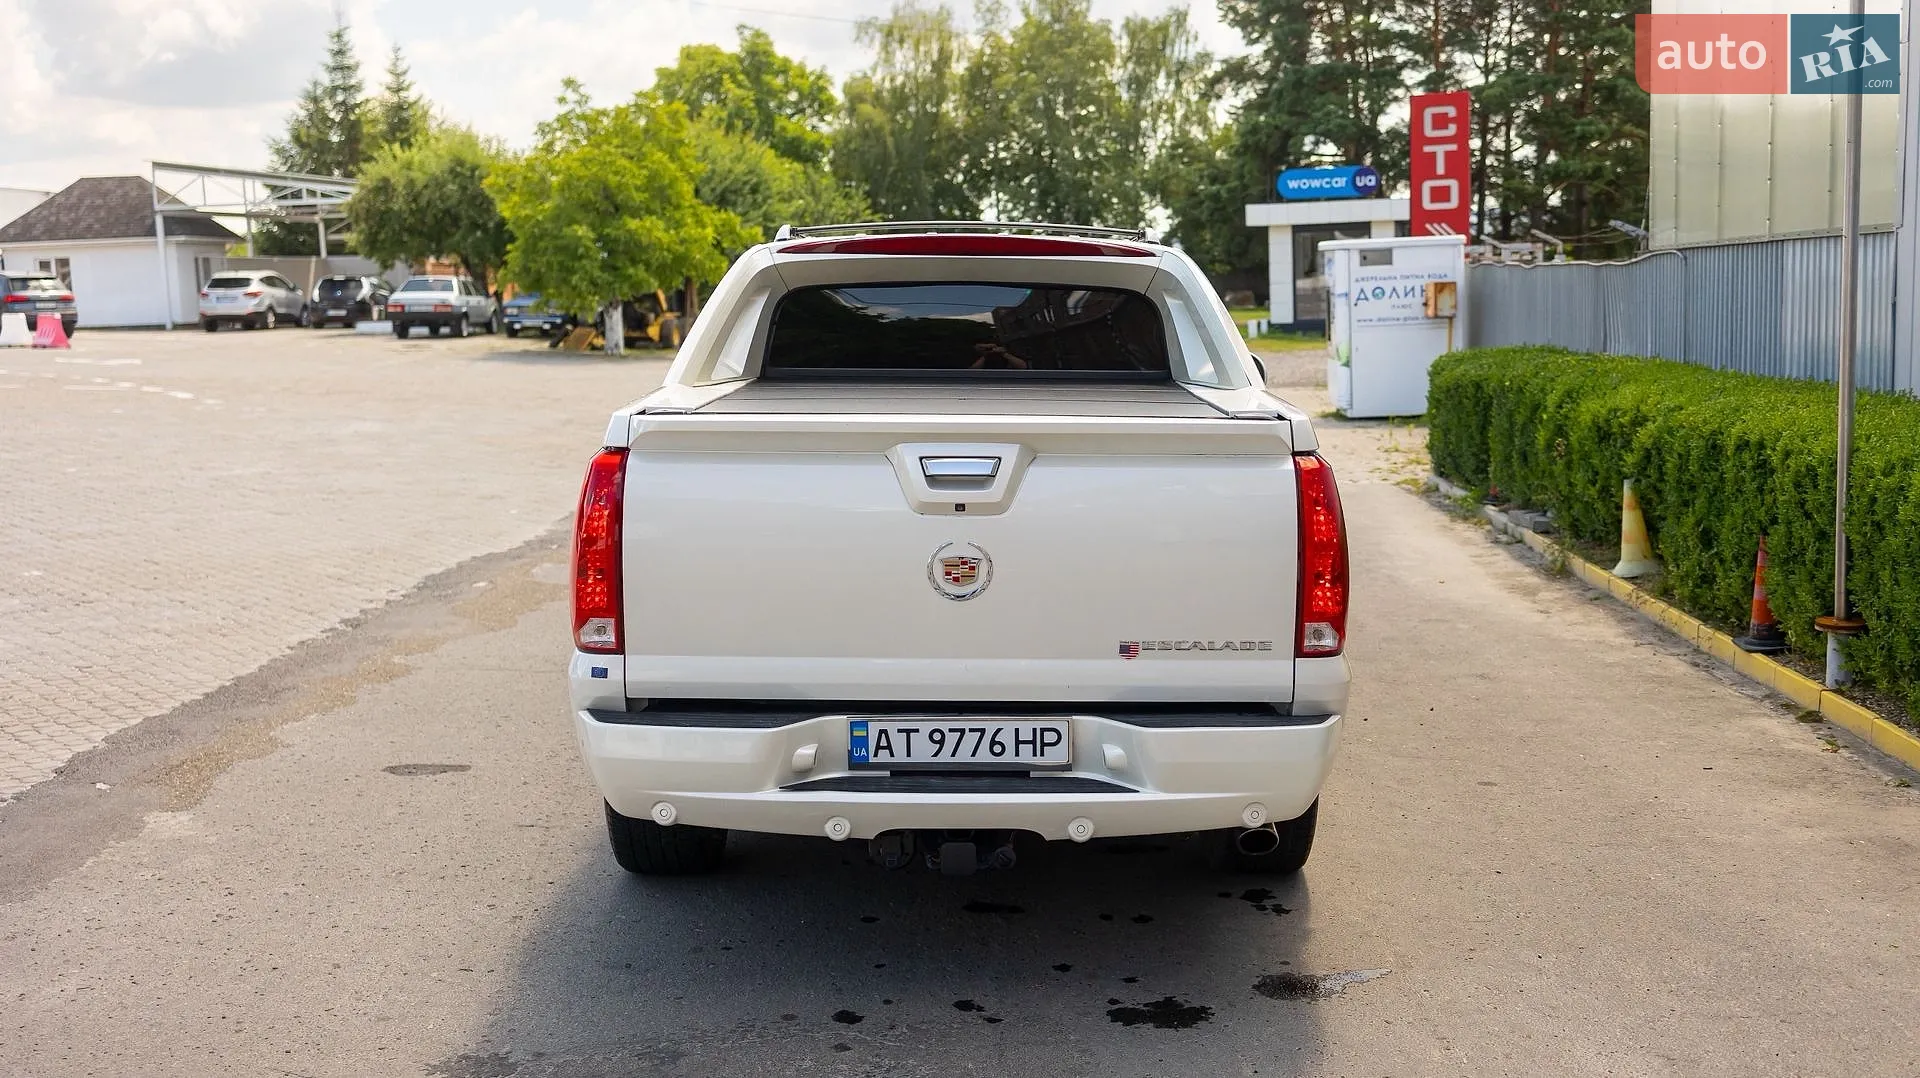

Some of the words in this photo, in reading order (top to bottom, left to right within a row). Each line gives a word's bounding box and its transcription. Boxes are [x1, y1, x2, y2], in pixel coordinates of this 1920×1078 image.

[1421, 105, 1460, 211] СТО
[1287, 176, 1347, 190] wowcar
[1355, 174, 1377, 187] ua
[1141, 640, 1273, 651] ESCALADE
[873, 728, 919, 758] AT
[928, 727, 1007, 758] 9776
[1014, 727, 1063, 758] HP
[853, 747, 868, 757] UA
